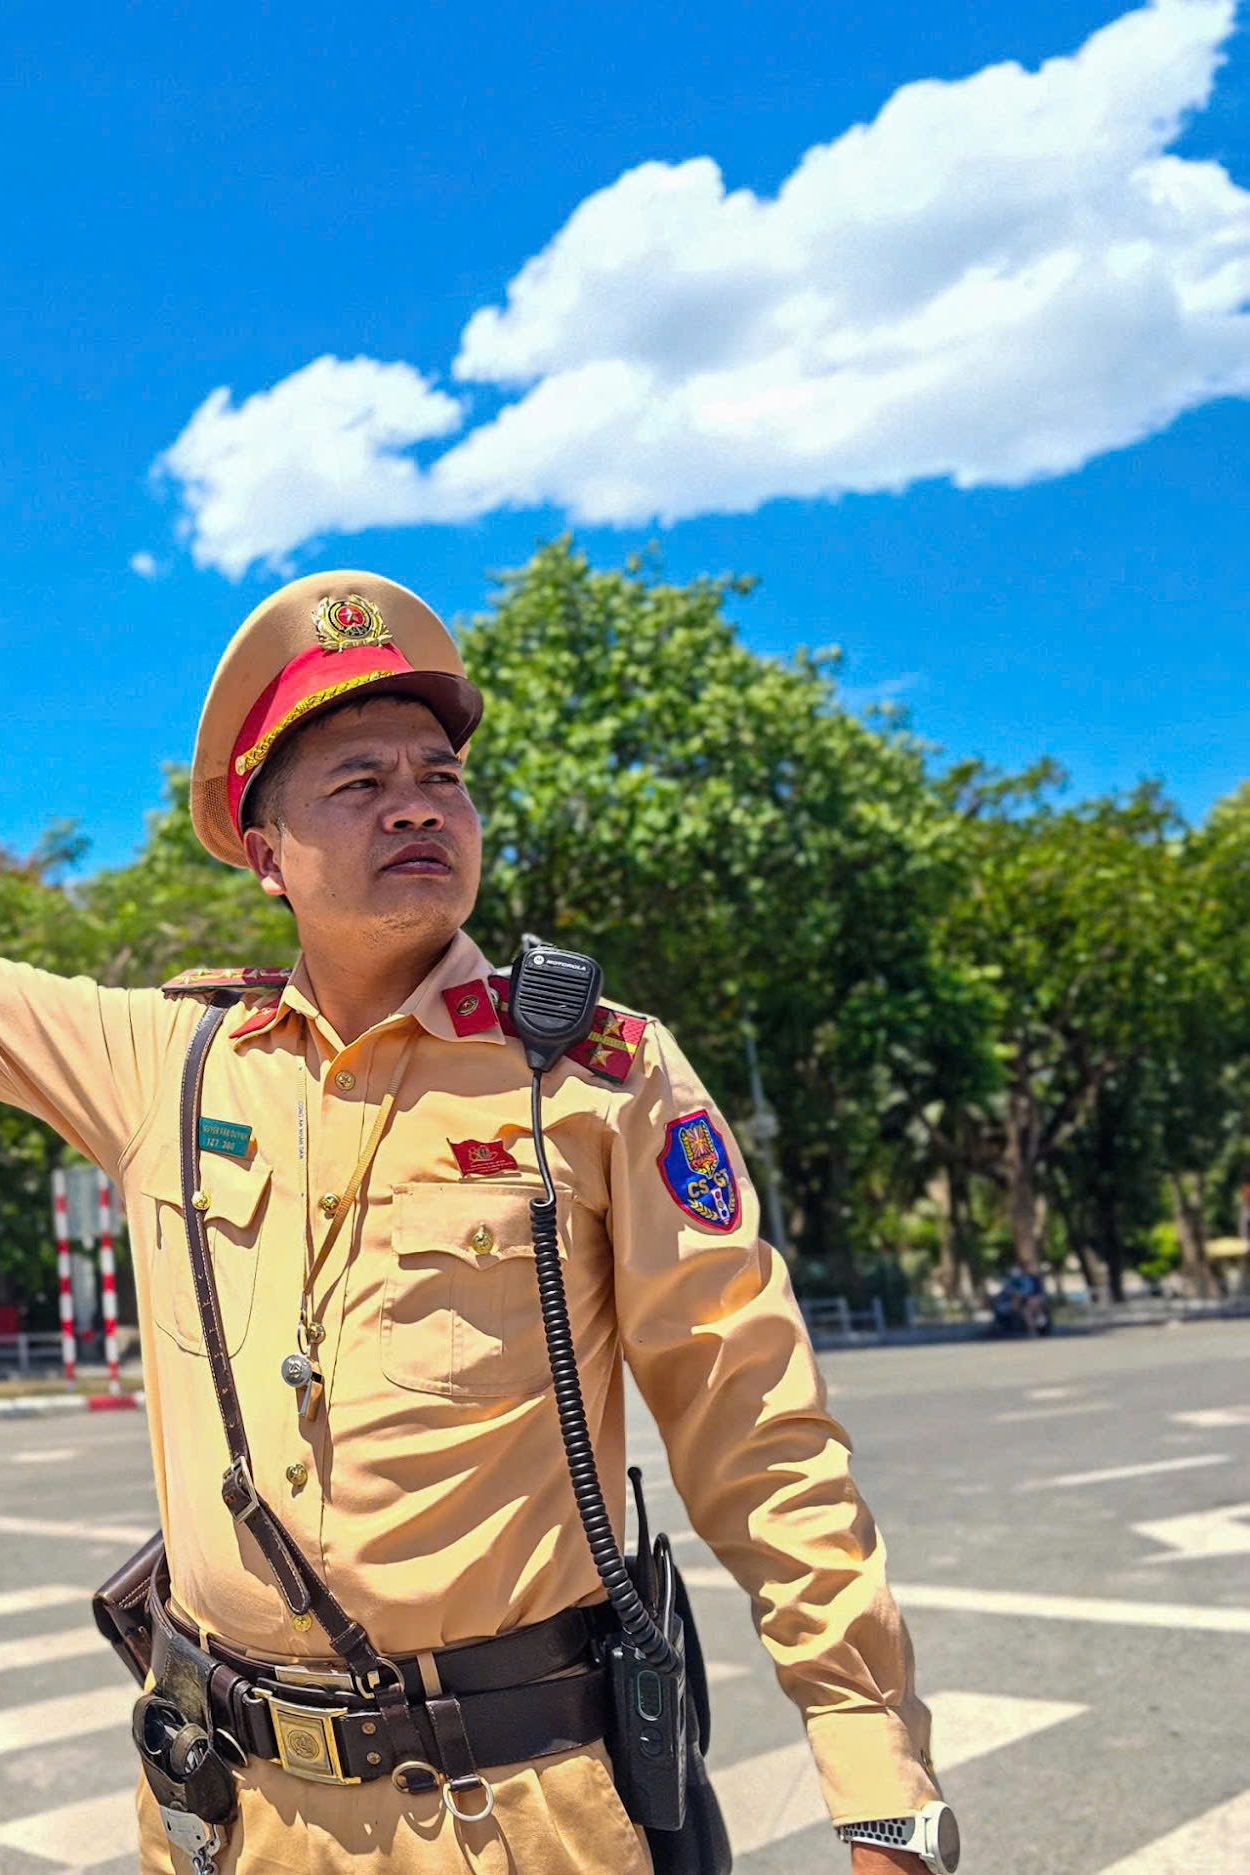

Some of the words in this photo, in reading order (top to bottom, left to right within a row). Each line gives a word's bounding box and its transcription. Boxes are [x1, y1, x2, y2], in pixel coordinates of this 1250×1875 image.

[546, 959, 587, 971] MOTOROLA
[687, 1178, 710, 1199] CS
[713, 1168, 731, 1188] GT
